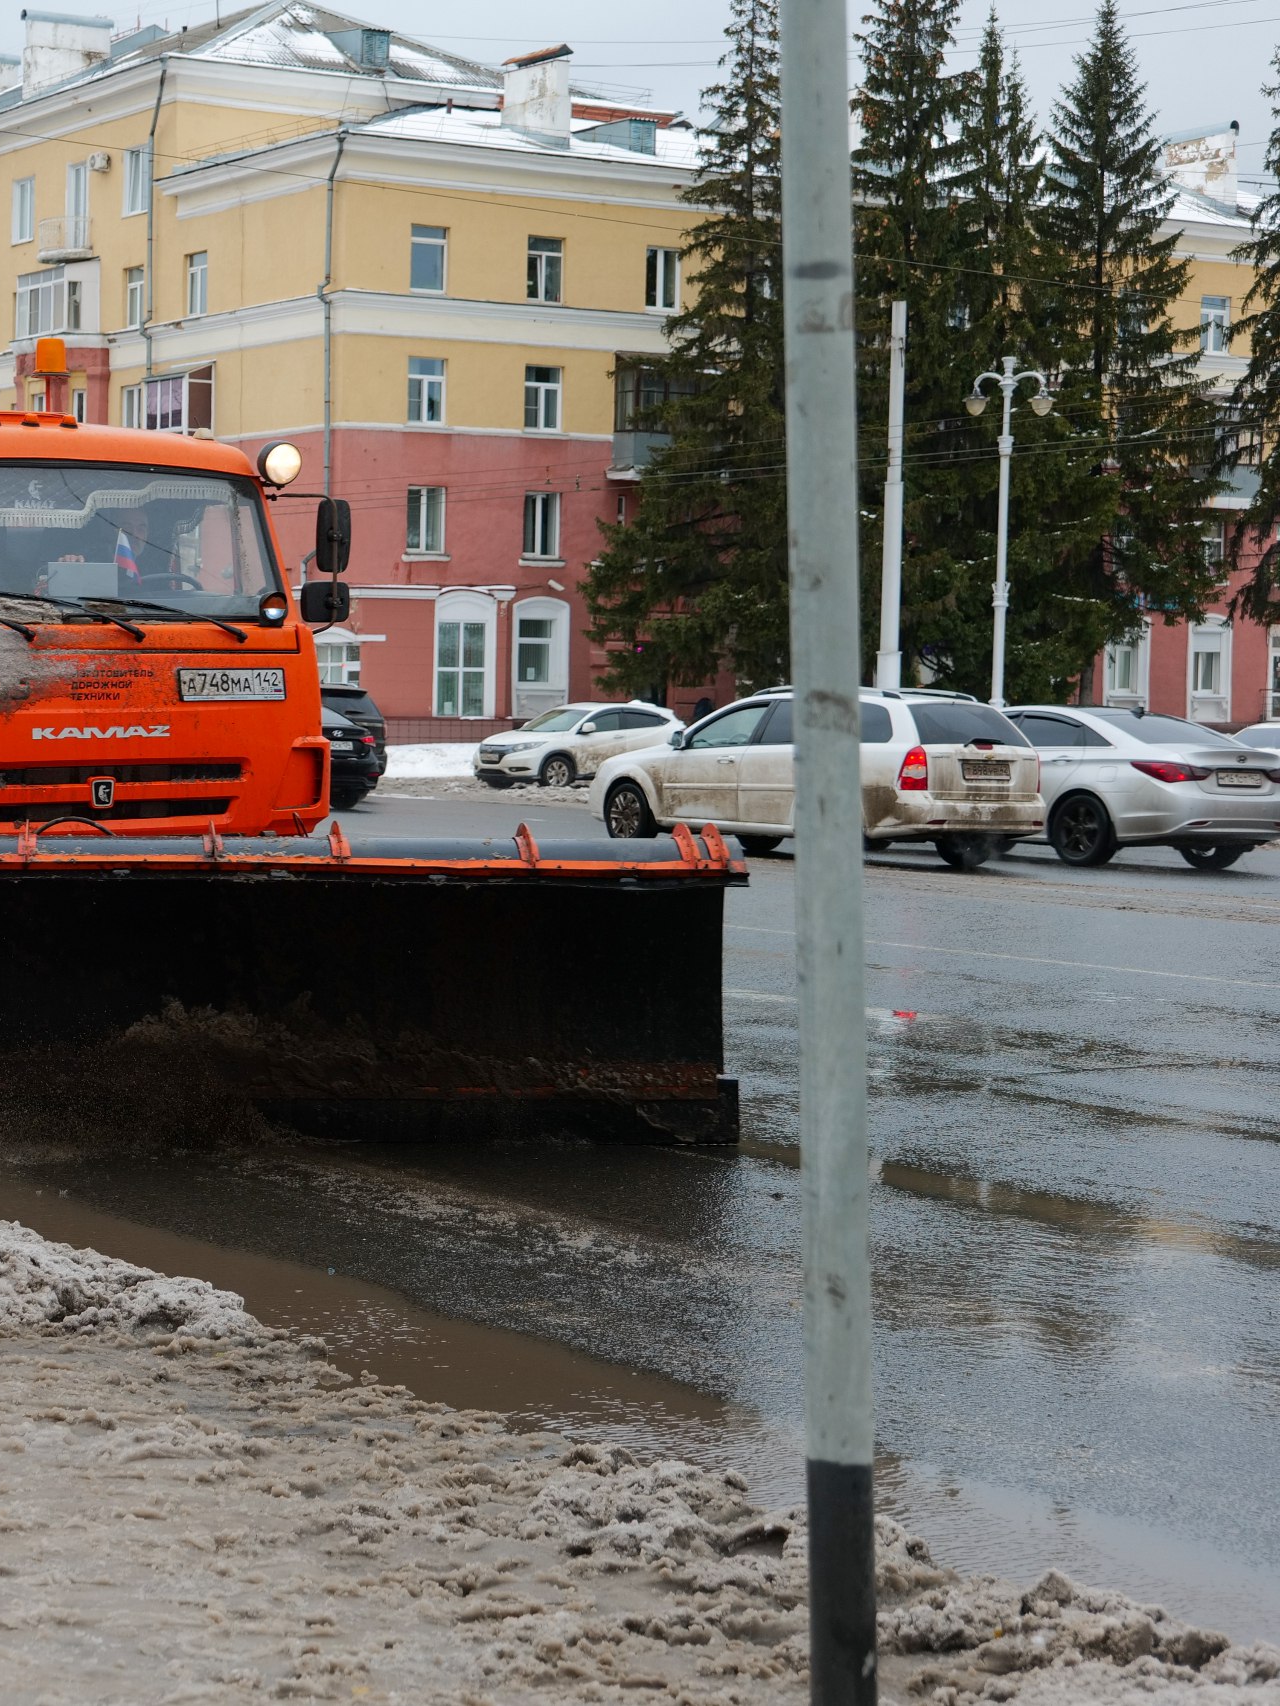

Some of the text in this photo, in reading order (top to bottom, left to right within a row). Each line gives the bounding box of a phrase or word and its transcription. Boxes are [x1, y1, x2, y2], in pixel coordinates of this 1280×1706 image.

[71, 680, 133, 689] ДОРОЖНОЙ
[254, 671, 279, 687] 142
[71, 692, 120, 701] ТЕХНИКИ
[32, 726, 170, 739] KAMAZ
